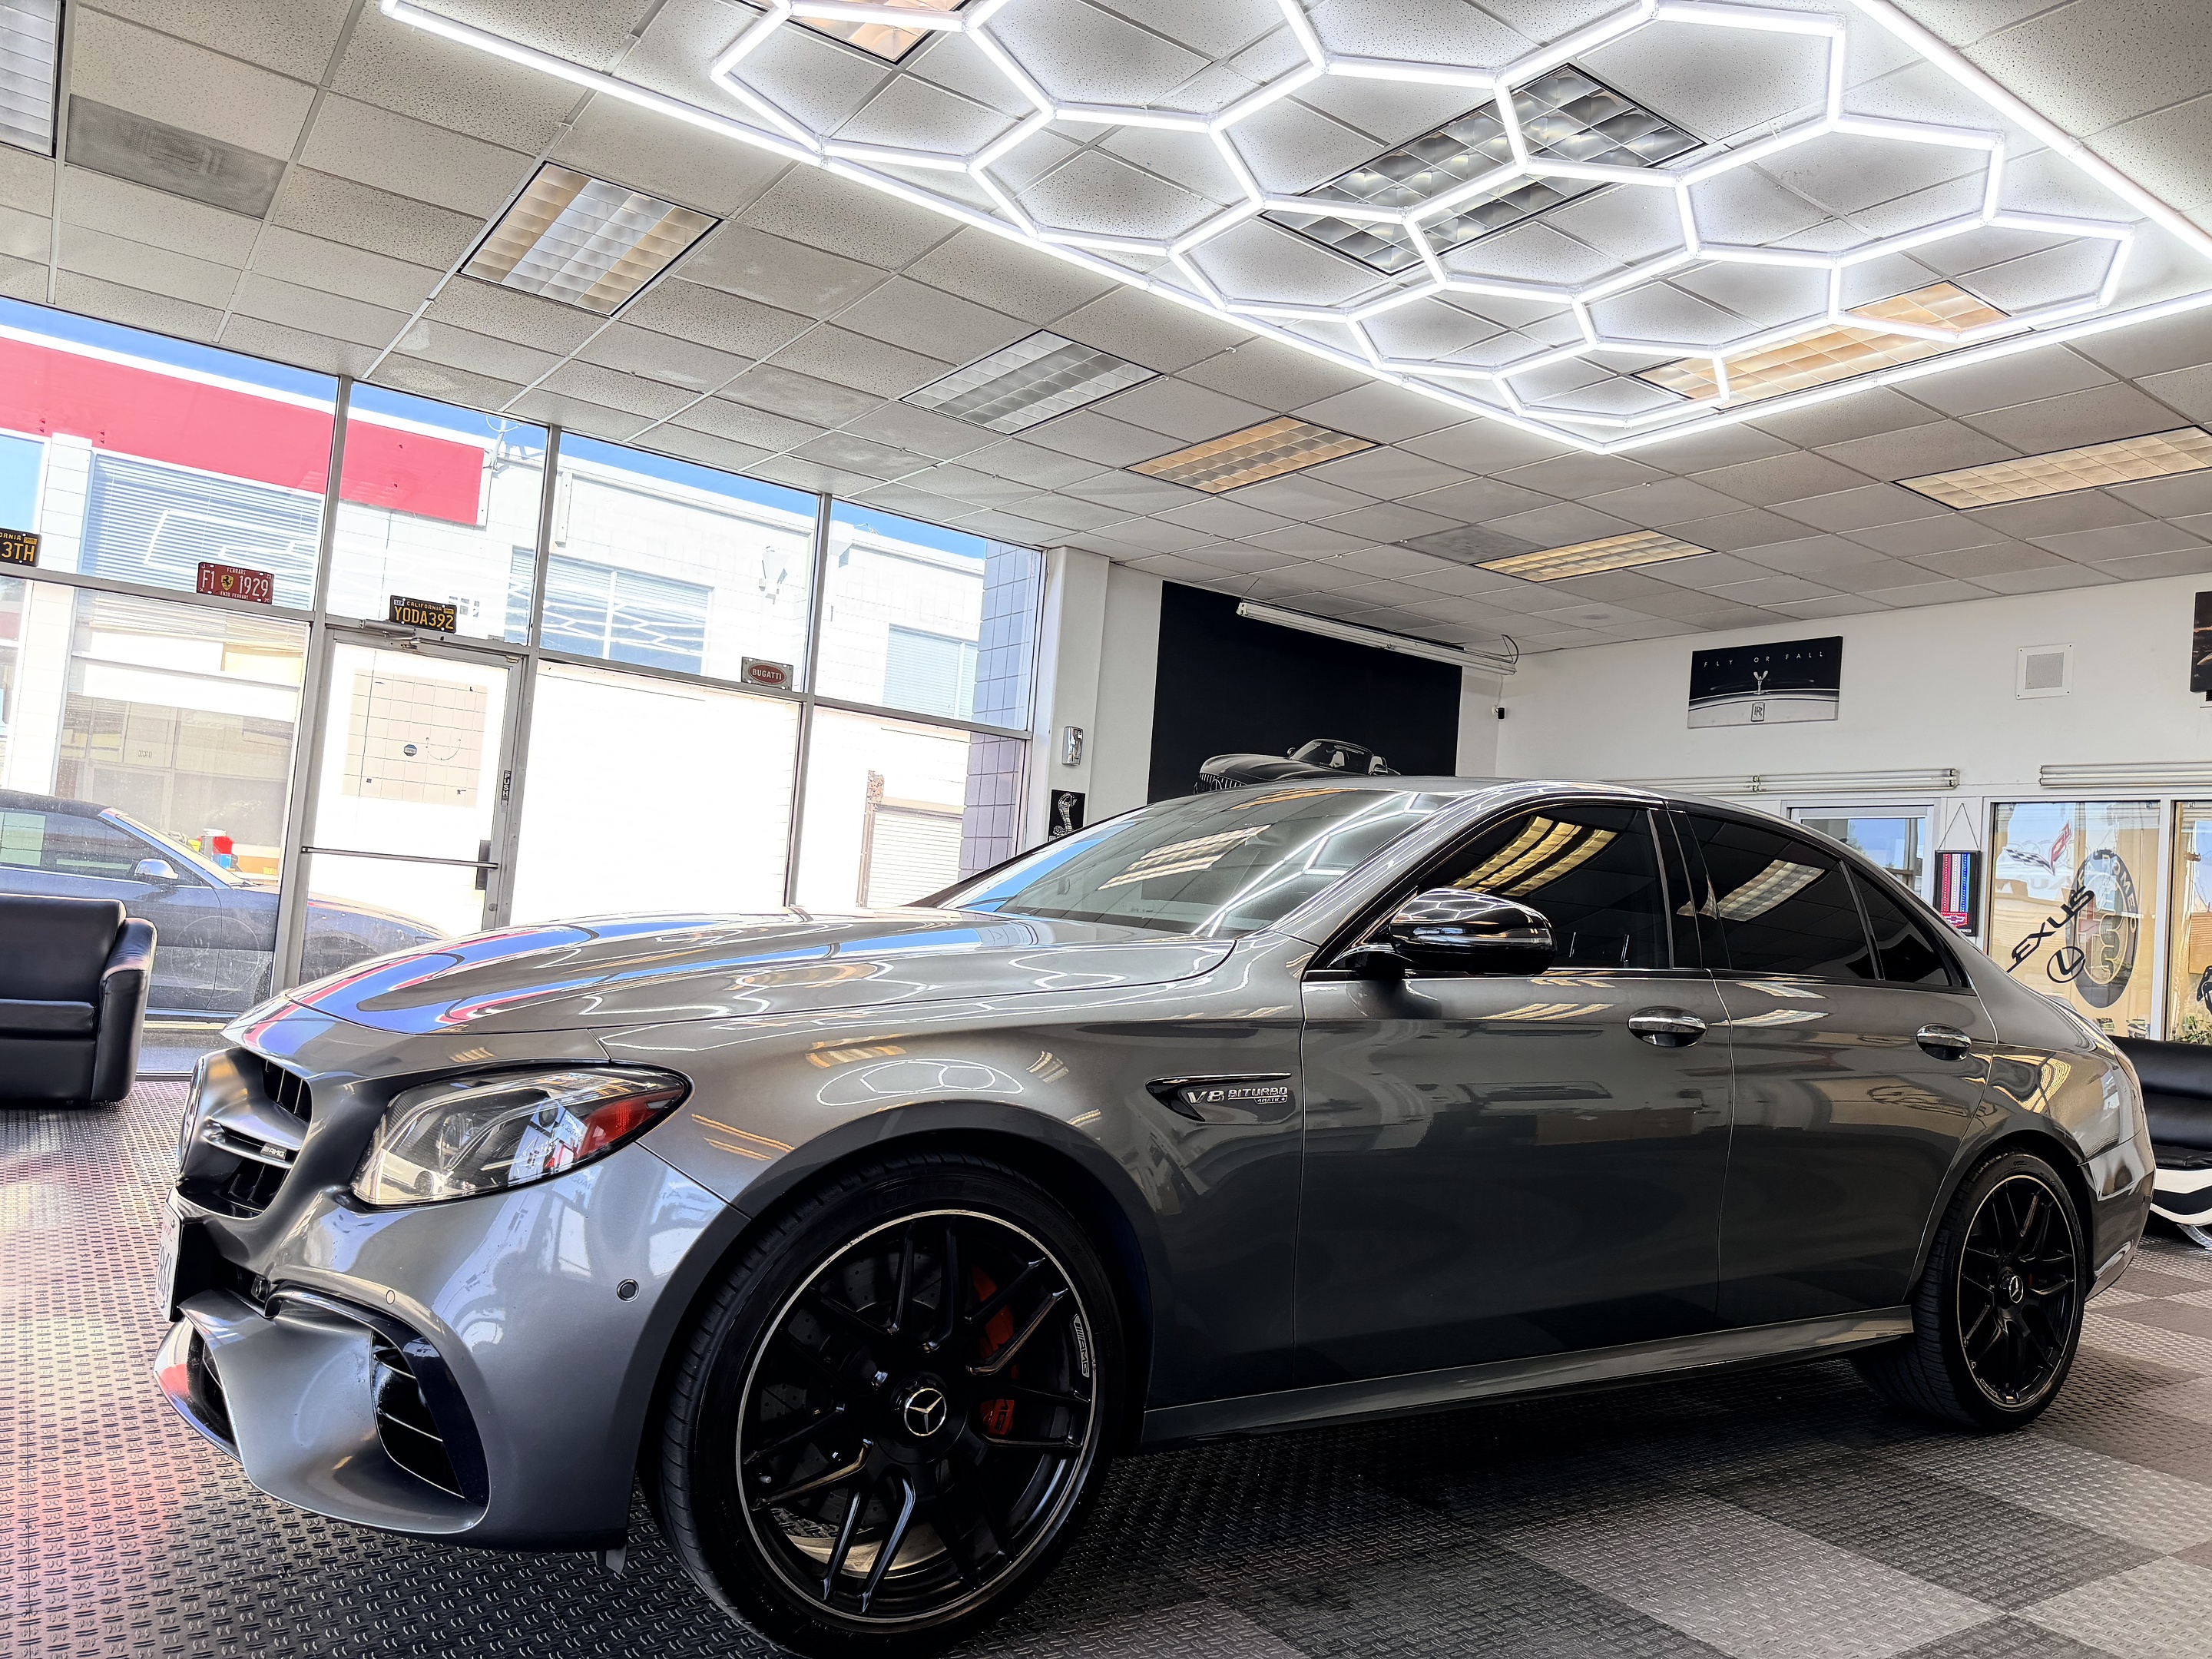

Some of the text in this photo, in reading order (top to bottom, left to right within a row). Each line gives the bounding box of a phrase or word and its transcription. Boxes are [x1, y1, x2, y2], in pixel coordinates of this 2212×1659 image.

[2, 541, 35, 561] 3TH
[227, 567, 247, 575] FERRARI
[202, 569, 269, 598] F1 1929
[406, 601, 442, 611] CALIFORNIA
[394, 605, 454, 630] YODA392
[1704, 659, 1734, 667] FLY
[1785, 651, 1823, 661] FALL
[752, 668, 782, 680] BUGATTI
[502, 773, 511, 796] PUSH
[1187, 1086, 1288, 1104] V8 BITURBO
[269, 1147, 285, 1157] AMG
[1078, 1339, 1089, 1374] AMG
